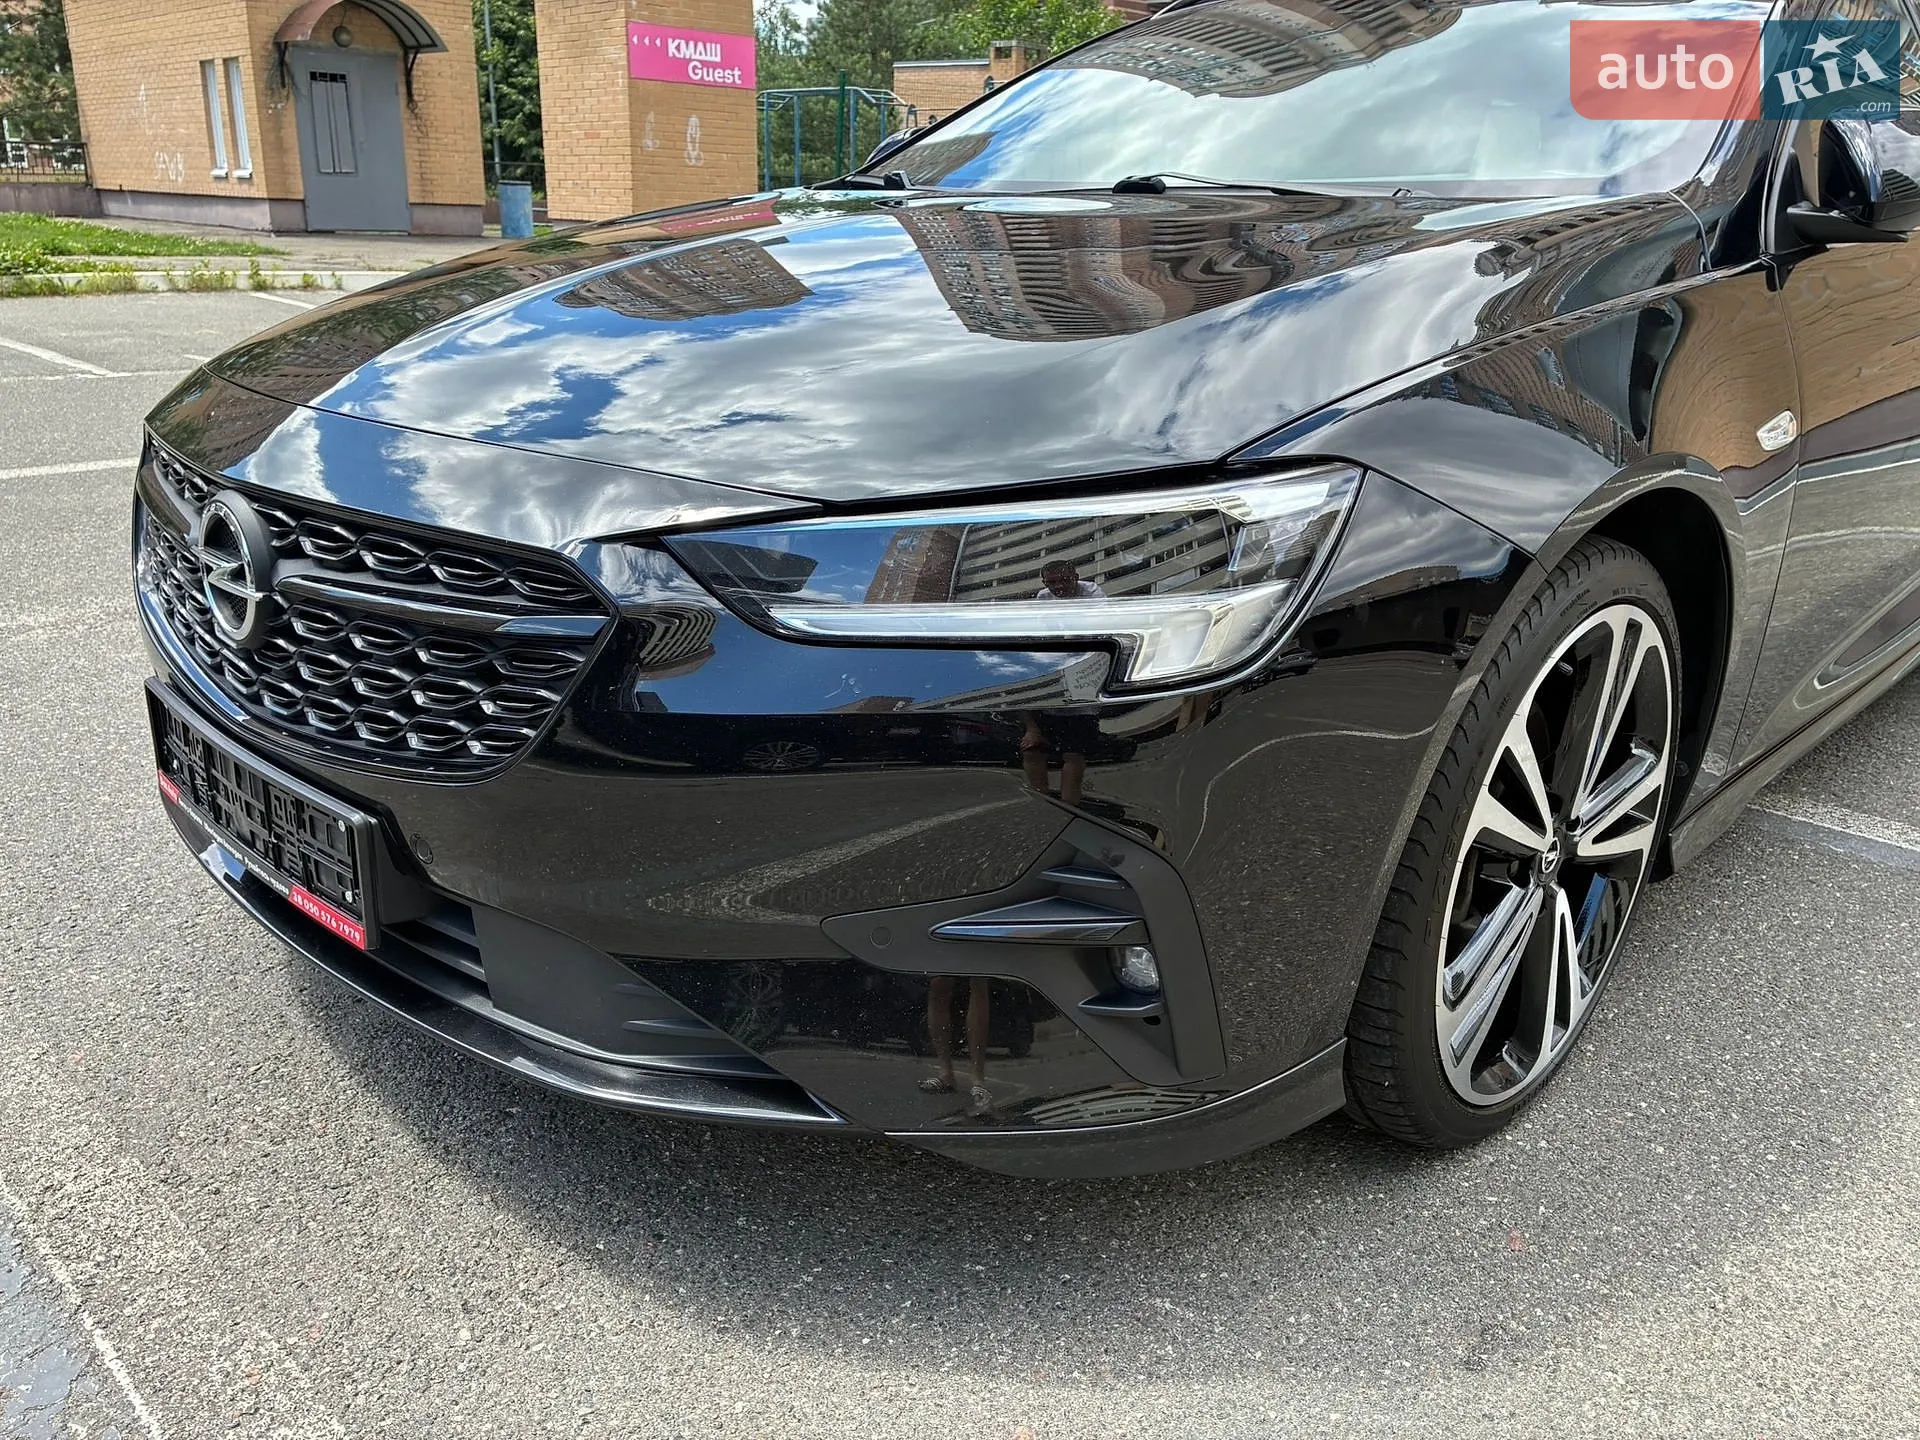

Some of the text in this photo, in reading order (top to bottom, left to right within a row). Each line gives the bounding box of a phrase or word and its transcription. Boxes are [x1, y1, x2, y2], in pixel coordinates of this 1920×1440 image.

[688, 60, 742, 84] Guest
[303, 899, 320, 917] 050
[320, 911, 337, 929] 576
[338, 920, 361, 943] 7979
